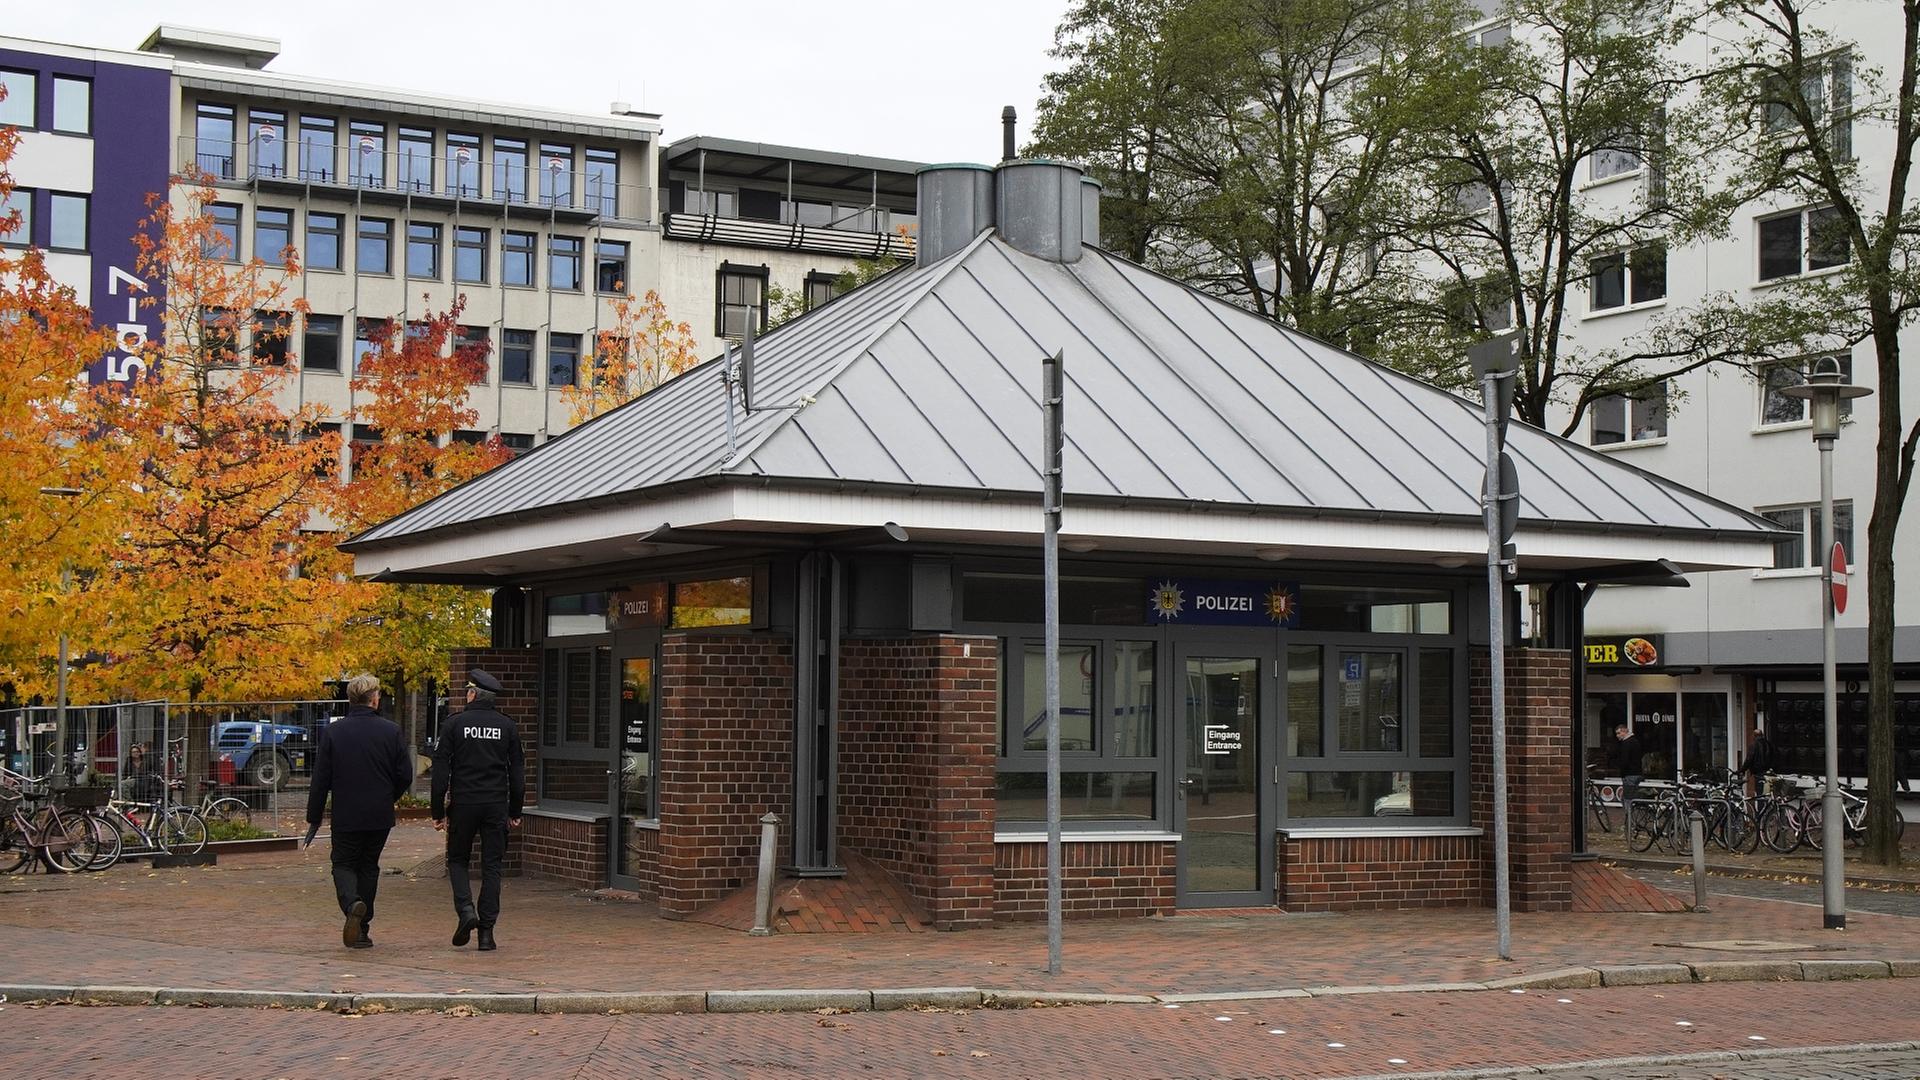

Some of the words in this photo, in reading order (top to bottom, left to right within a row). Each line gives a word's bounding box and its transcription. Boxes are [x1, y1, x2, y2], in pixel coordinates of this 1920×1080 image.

[624, 600, 649, 616] POLIZEI
[1196, 596, 1253, 612] POLIZEI
[464, 726, 501, 740] POLIZEI
[1209, 730, 1241, 741] Eingang
[1208, 741, 1242, 749] Entrance
